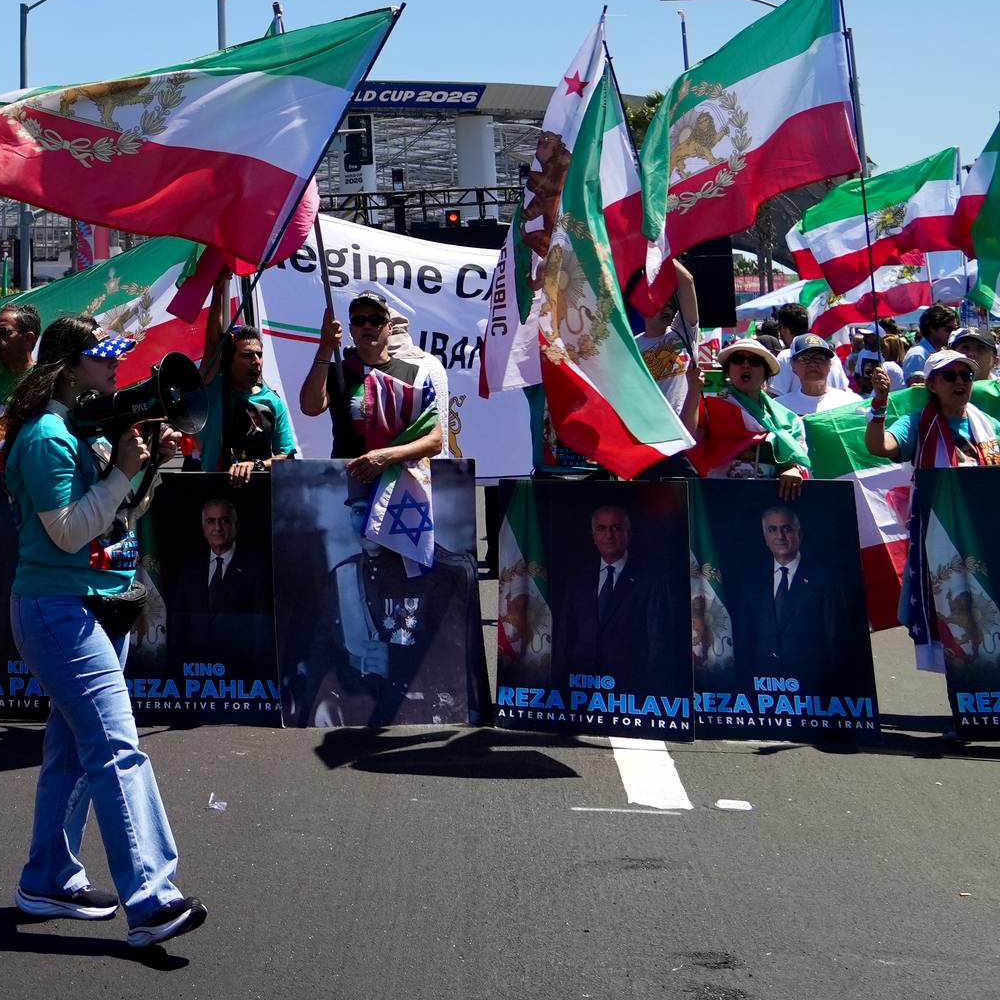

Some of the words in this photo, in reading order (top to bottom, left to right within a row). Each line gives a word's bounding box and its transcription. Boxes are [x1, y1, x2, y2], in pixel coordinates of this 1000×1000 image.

[379, 90, 415, 102] CUP
[415, 90, 478, 103] 2026
[278, 243, 443, 294] egime
[131, 403, 148, 414] PYLE
[183, 662, 226, 676] KING
[186, 679, 281, 699] PAHLAV
[569, 673, 616, 690] KING
[753, 676, 799, 692] KING
[131, 701, 216, 710] TERNATIVE
[224, 702, 250, 710] FOR
[258, 702, 283, 710] IRA
[498, 686, 565, 710] REZA
[570, 691, 690, 718] PAHLAVI
[757, 694, 873, 718] PAHLAVI
[498, 709, 604, 724] ALTERNATIVE
[613, 717, 641, 727] FOR
[651, 719, 690, 730] IRAN
[699, 716, 792, 727] LTERNATIVE
[801, 719, 828, 728] FOR
[838, 721, 875, 730] IRAN
[961, 716, 999, 725] ALTE
